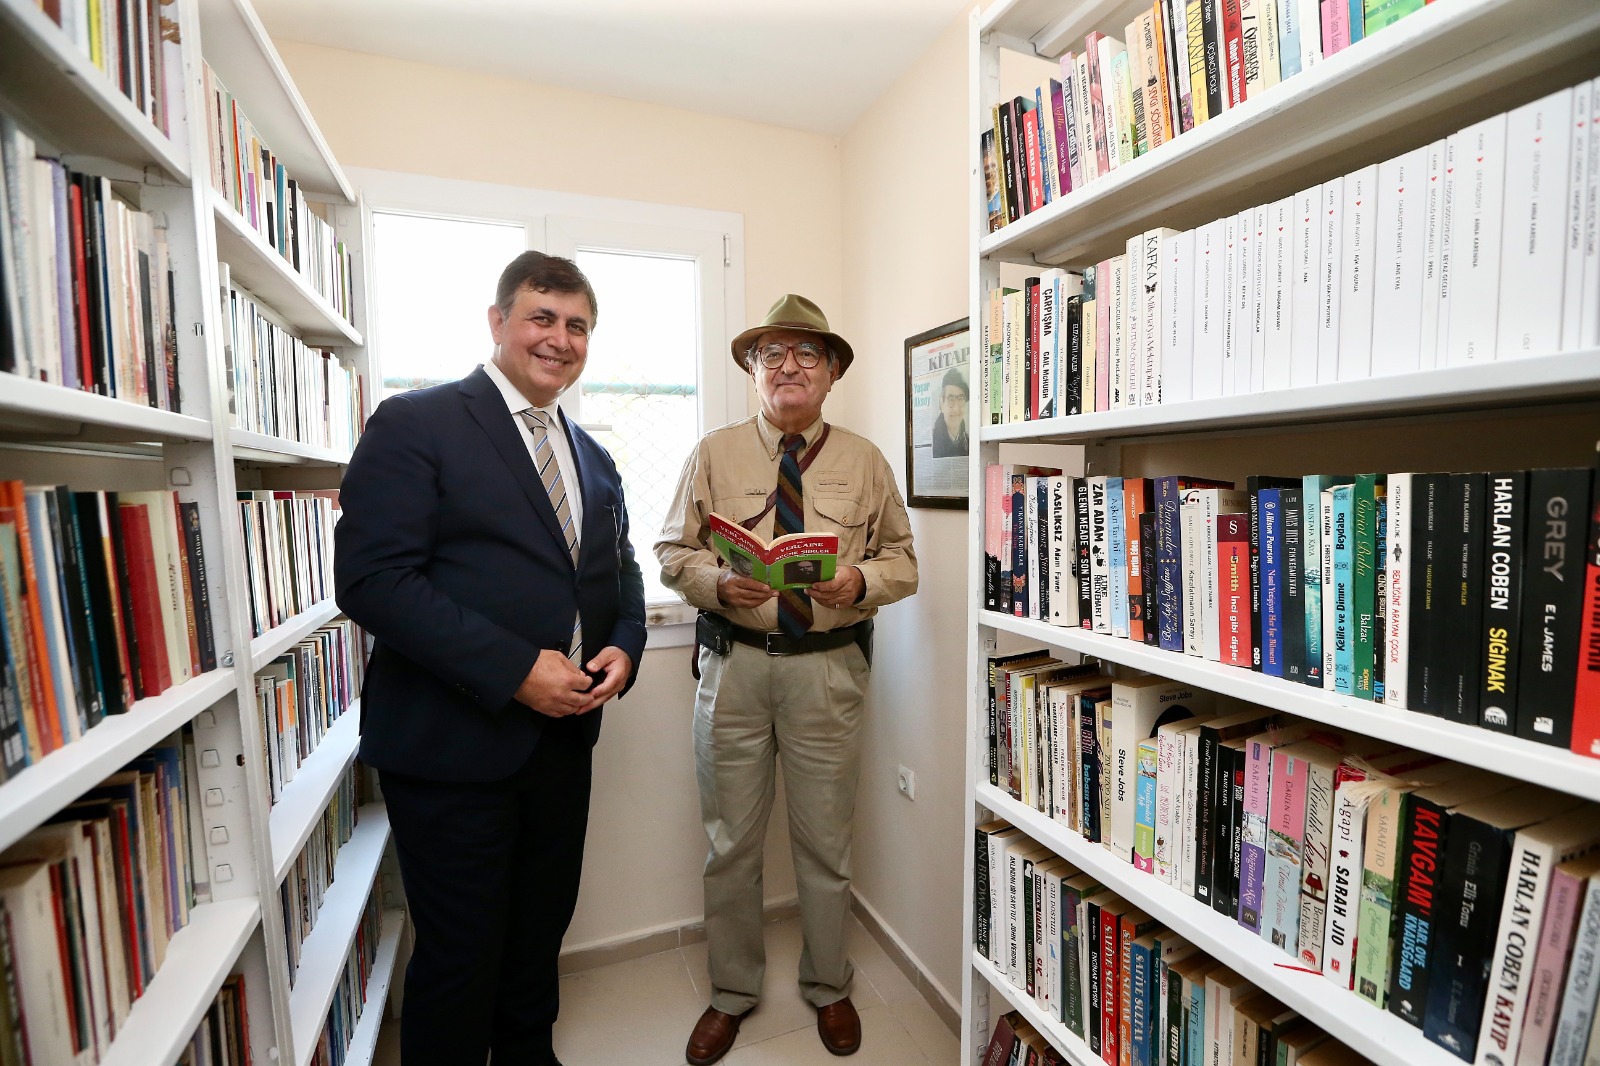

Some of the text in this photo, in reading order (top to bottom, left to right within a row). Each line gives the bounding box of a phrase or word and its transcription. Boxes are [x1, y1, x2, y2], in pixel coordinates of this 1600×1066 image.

[1229, 37, 1239, 63] Robert
[1244, 28, 1260, 85] ÖZGÜRLÜĞE
[1146, 235, 1158, 281] KAFKA
[1042, 288, 1053, 336] ÇARPIŞMA
[1054, 482, 1062, 542] OLASILIKSIZ
[1092, 484, 1104, 542] ZAR ADAM
[1110, 498, 1121, 552] Aşkın Tarihi
[1165, 500, 1177, 556] Denemeler
[1266, 511, 1274, 534] Allison
[1286, 508, 1298, 527] JAMES
[1307, 504, 1316, 557] MUSTAFA KAYA
[1336, 512, 1345, 550] Beydaba
[720, 526, 757, 550] VERLAINE
[780, 542, 824, 553] VERLAINE
[1078, 486, 1090, 600] GLENN MEADE SON TANIK
[1130, 540, 1140, 576] Martin Eden
[1266, 536, 1274, 564] Pearson
[1543, 496, 1568, 583] GREY
[1252, 556, 1260, 584] Doğu'nun
[1268, 570, 1276, 586] Nasıl
[1357, 497, 1372, 643] Goriot Baba Balzac
[1392, 570, 1402, 607] BENLİĞİNİ
[1487, 478, 1513, 694] HARLAN COBEN SIĞINAK
[1094, 574, 1102, 618] RHINEHART
[1229, 556, 1240, 662] Smith İnci gibi dişler
[1336, 583, 1346, 651] Kelile ve Dimne
[1376, 574, 1386, 619] James BOND
[1546, 604, 1556, 612] E
[1391, 608, 1400, 637] ARAYAN
[1269, 638, 1277, 665] Bilmem!
[1390, 638, 1400, 663] ÇOCUK
[1542, 627, 1554, 672] JAMES
[1160, 692, 1192, 703] Steve Jobs
[1118, 748, 1126, 802] Steve Jobs
[1252, 764, 1260, 794] SARAH
[1278, 780, 1294, 892] DARIEN GEE Umut
[1304, 771, 1332, 870] Kiralık Ten
[1375, 814, 1388, 868] SARAH JIO
[978, 832, 988, 914] DAN BROWN
[1245, 849, 1258, 888] Böğürtlen
[1332, 797, 1354, 946] Agapi SARAH JIO
[1406, 806, 1440, 909] KAVGAM
[1459, 842, 1482, 928] Grinin Elli Tonu
[1300, 898, 1312, 948] McFadden
[1312, 905, 1324, 942] Bernice
[1414, 918, 1429, 968] KARL OVE
[1092, 951, 1100, 980] ENGİNAR
[1104, 924, 1115, 1016] SAFİYE SULTAN
[1398, 913, 1417, 990] KNAUSGAARD
[1489, 849, 1541, 1052] HARLAN COBEN KAYIP
[1068, 950, 1078, 1016] ölmeden önce
[1122, 976, 1132, 1023] SULTAN
[1134, 953, 1146, 1044] SAFİYE SULTAN
